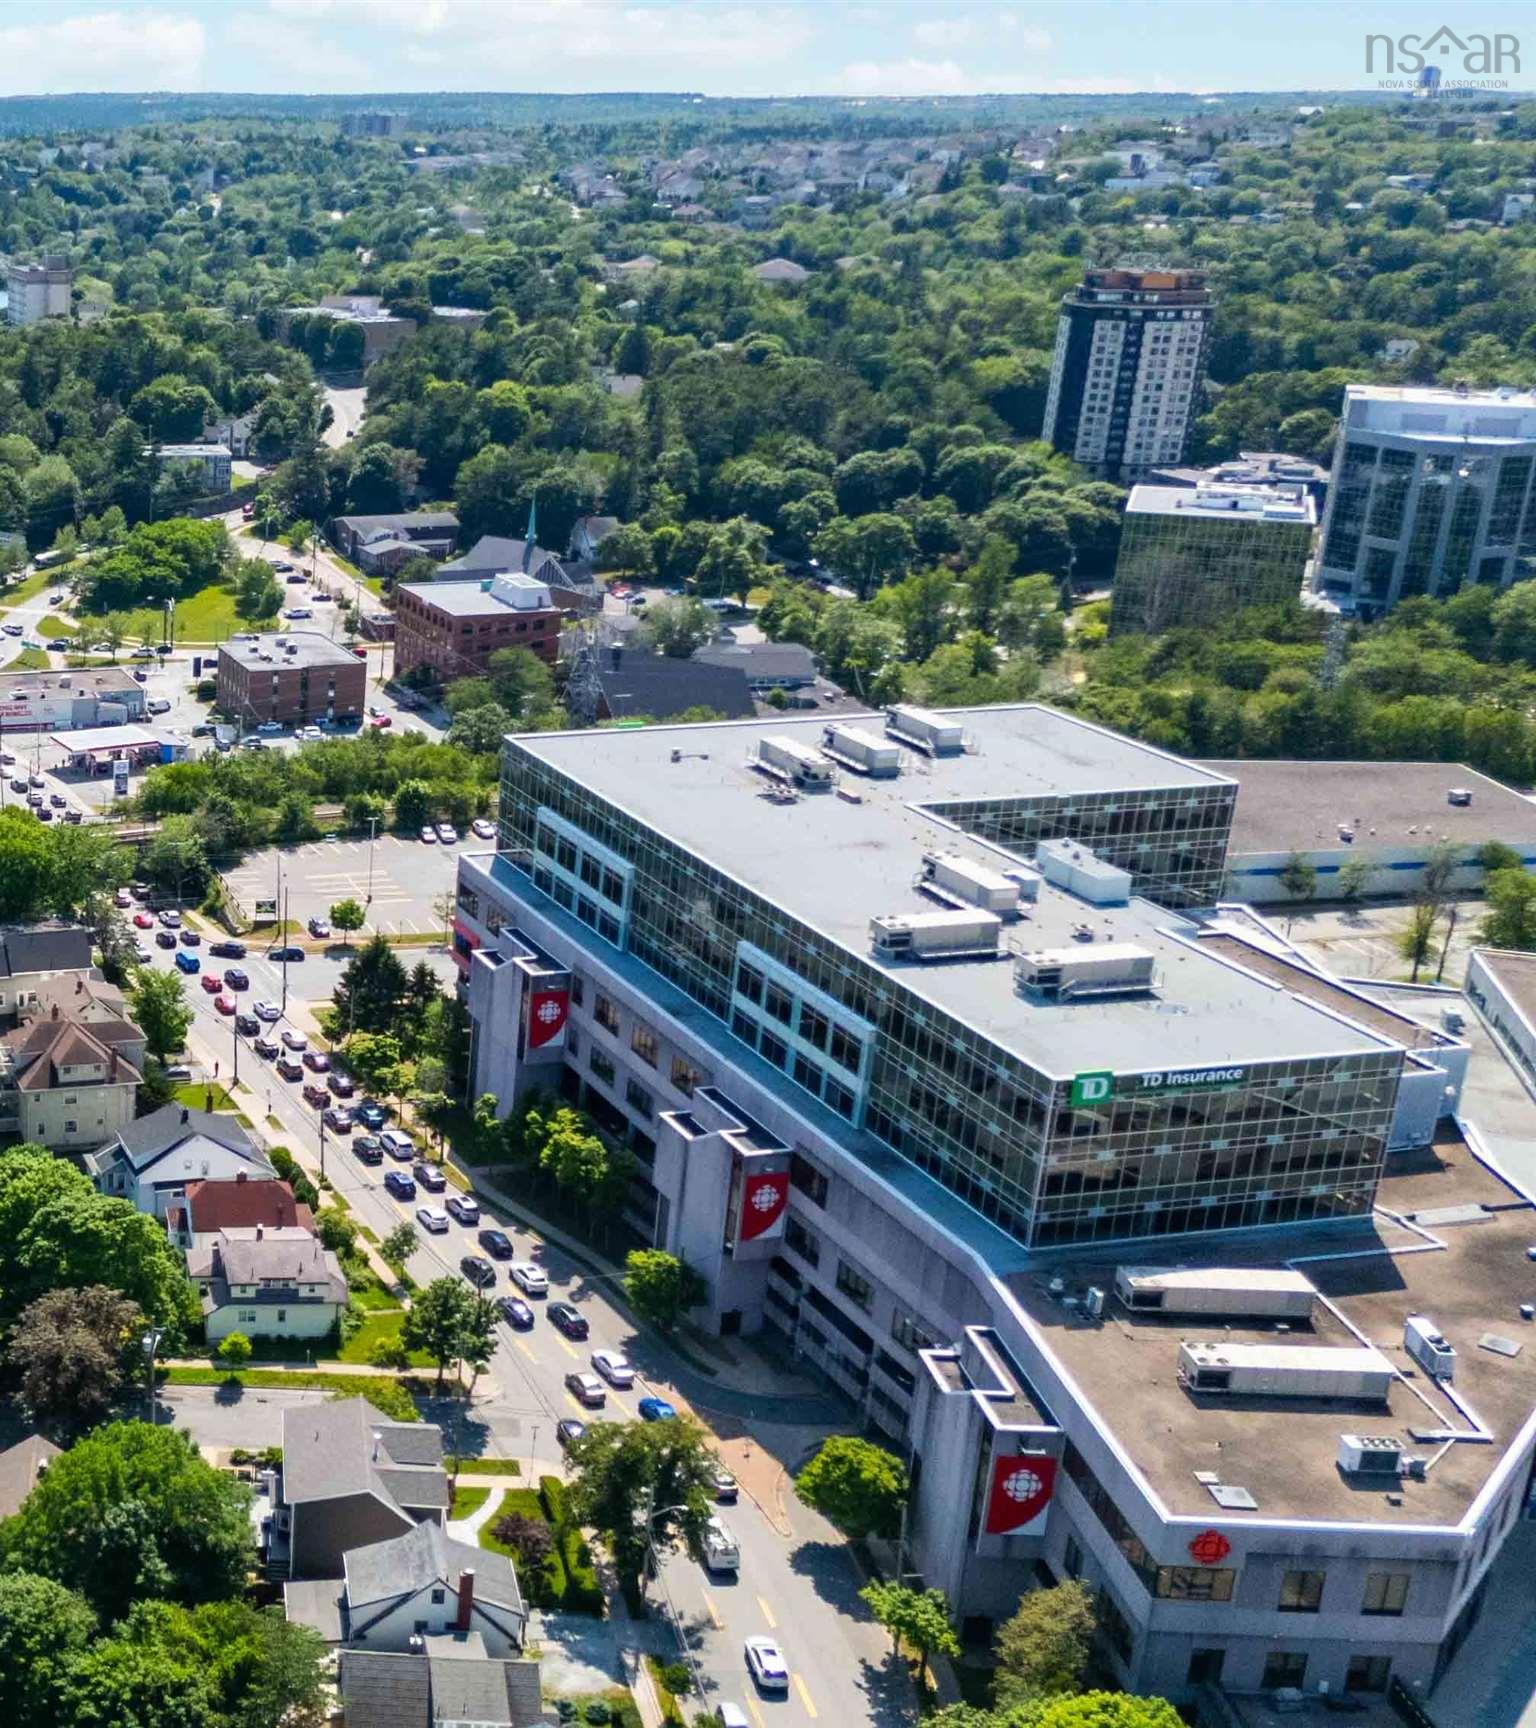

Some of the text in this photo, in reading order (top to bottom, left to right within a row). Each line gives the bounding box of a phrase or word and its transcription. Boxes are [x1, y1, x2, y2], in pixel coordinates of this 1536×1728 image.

[1142, 1067, 1244, 1087] TD Insurance
[1078, 1077, 1109, 1100] TD
